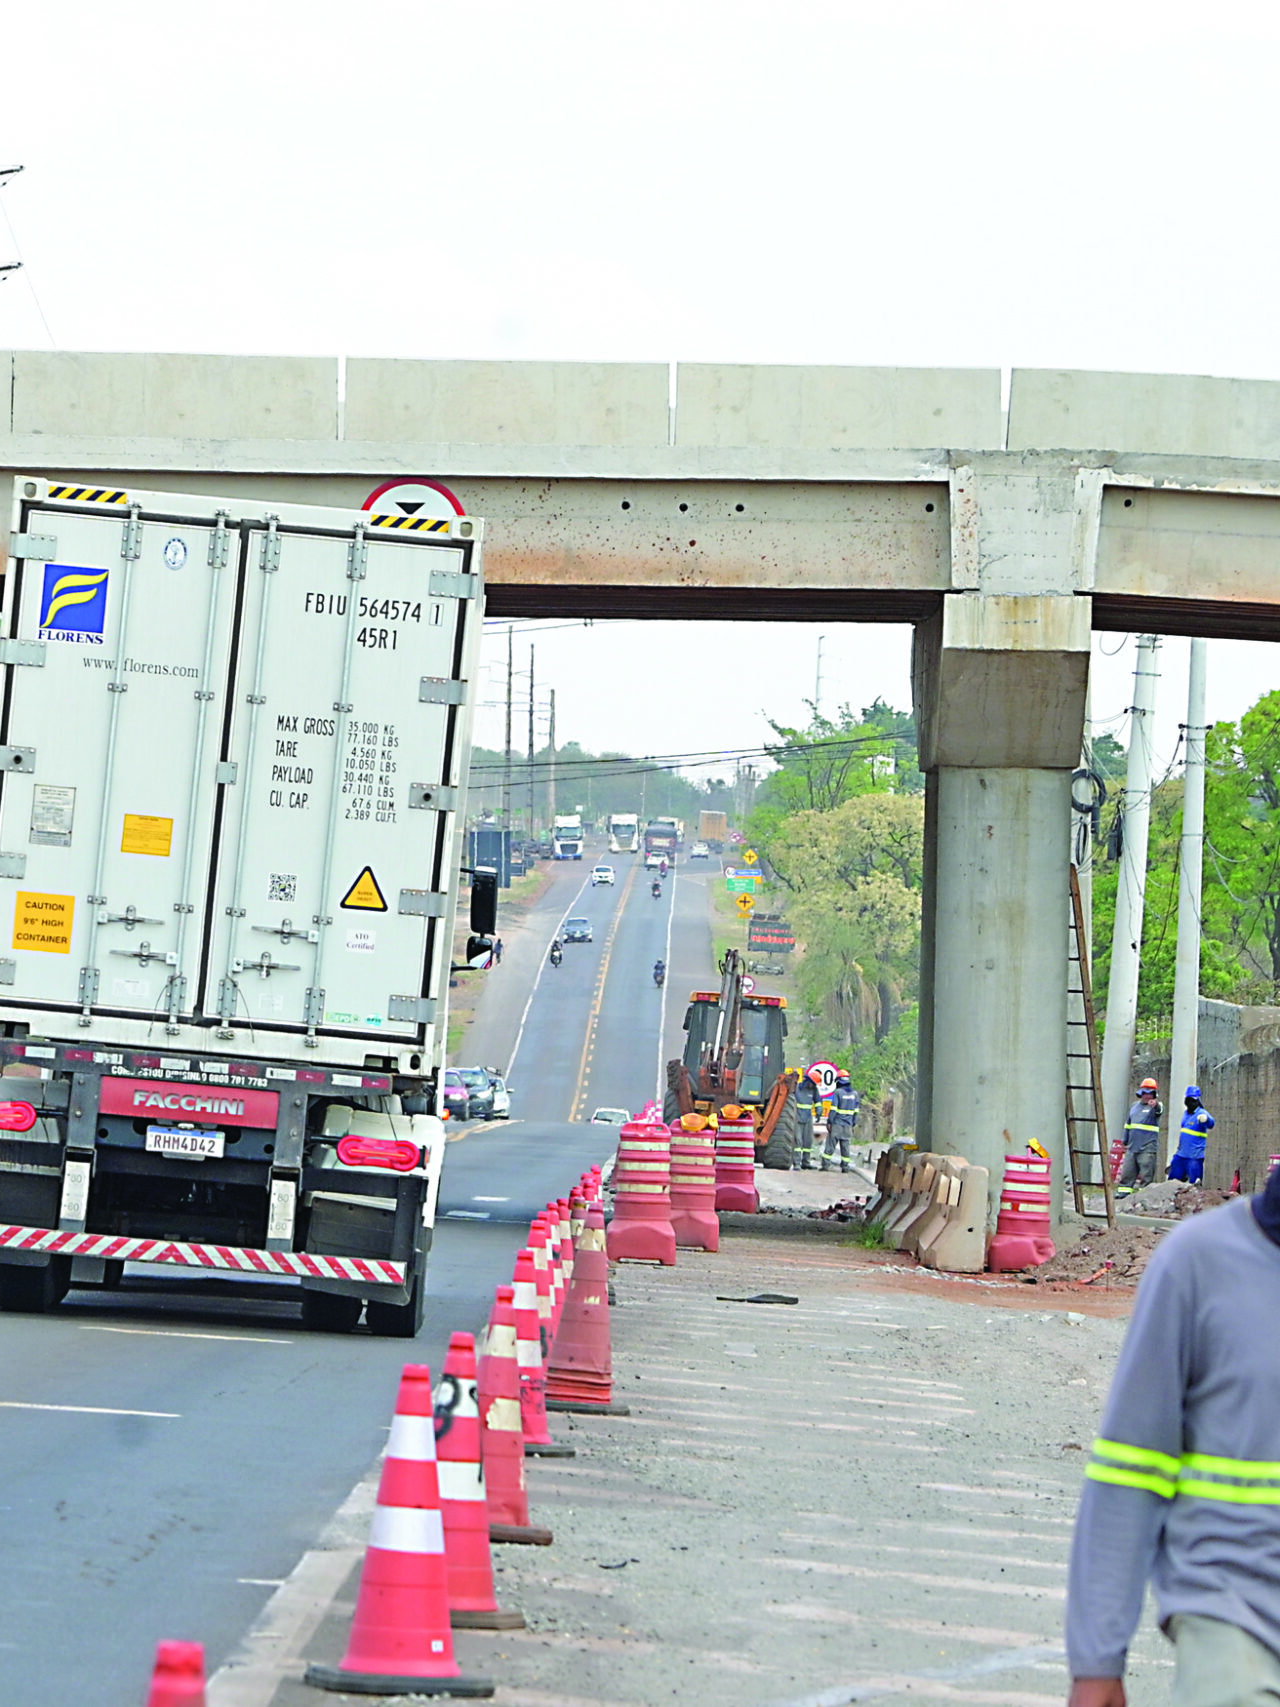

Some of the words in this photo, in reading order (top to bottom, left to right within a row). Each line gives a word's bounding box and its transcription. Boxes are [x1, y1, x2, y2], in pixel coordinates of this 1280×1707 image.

[305, 592, 347, 616] FBIU
[358, 597, 422, 623] 564574
[38, 629, 104, 645] FLORENS
[357, 627, 397, 650] 45R1
[276, 715, 299, 732] MAX
[303, 717, 335, 736] GROSS
[348, 721, 379, 734] 35.000
[383, 725, 395, 735] KG
[347, 733, 378, 746] 77.160
[382, 736, 399, 748] LBS
[275, 740, 299, 758] TARE
[351, 747, 377, 759] 4.560
[381, 750, 392, 760] KG
[345, 758, 375, 771] 10.050
[379, 761, 397, 773] LBS
[272, 765, 314, 784] PAYLOAD
[343, 771, 374, 784] 30.440
[378, 775, 390, 786] KG
[341, 783, 373, 796] 67.110
[377, 786, 394, 798] LBS
[269, 790, 284, 808] CU.
[289, 791, 310, 810] CAP.
[351, 798, 371, 810] 67.6
[345, 808, 371, 820] 2.389
[25, 901, 65, 911] CAUTION
[41, 918, 64, 928] HIGH
[16, 932, 68, 944] CONTAINER
[133, 1089, 245, 1116] FACCHINI
[153, 1134, 216, 1153] RHM4D42
